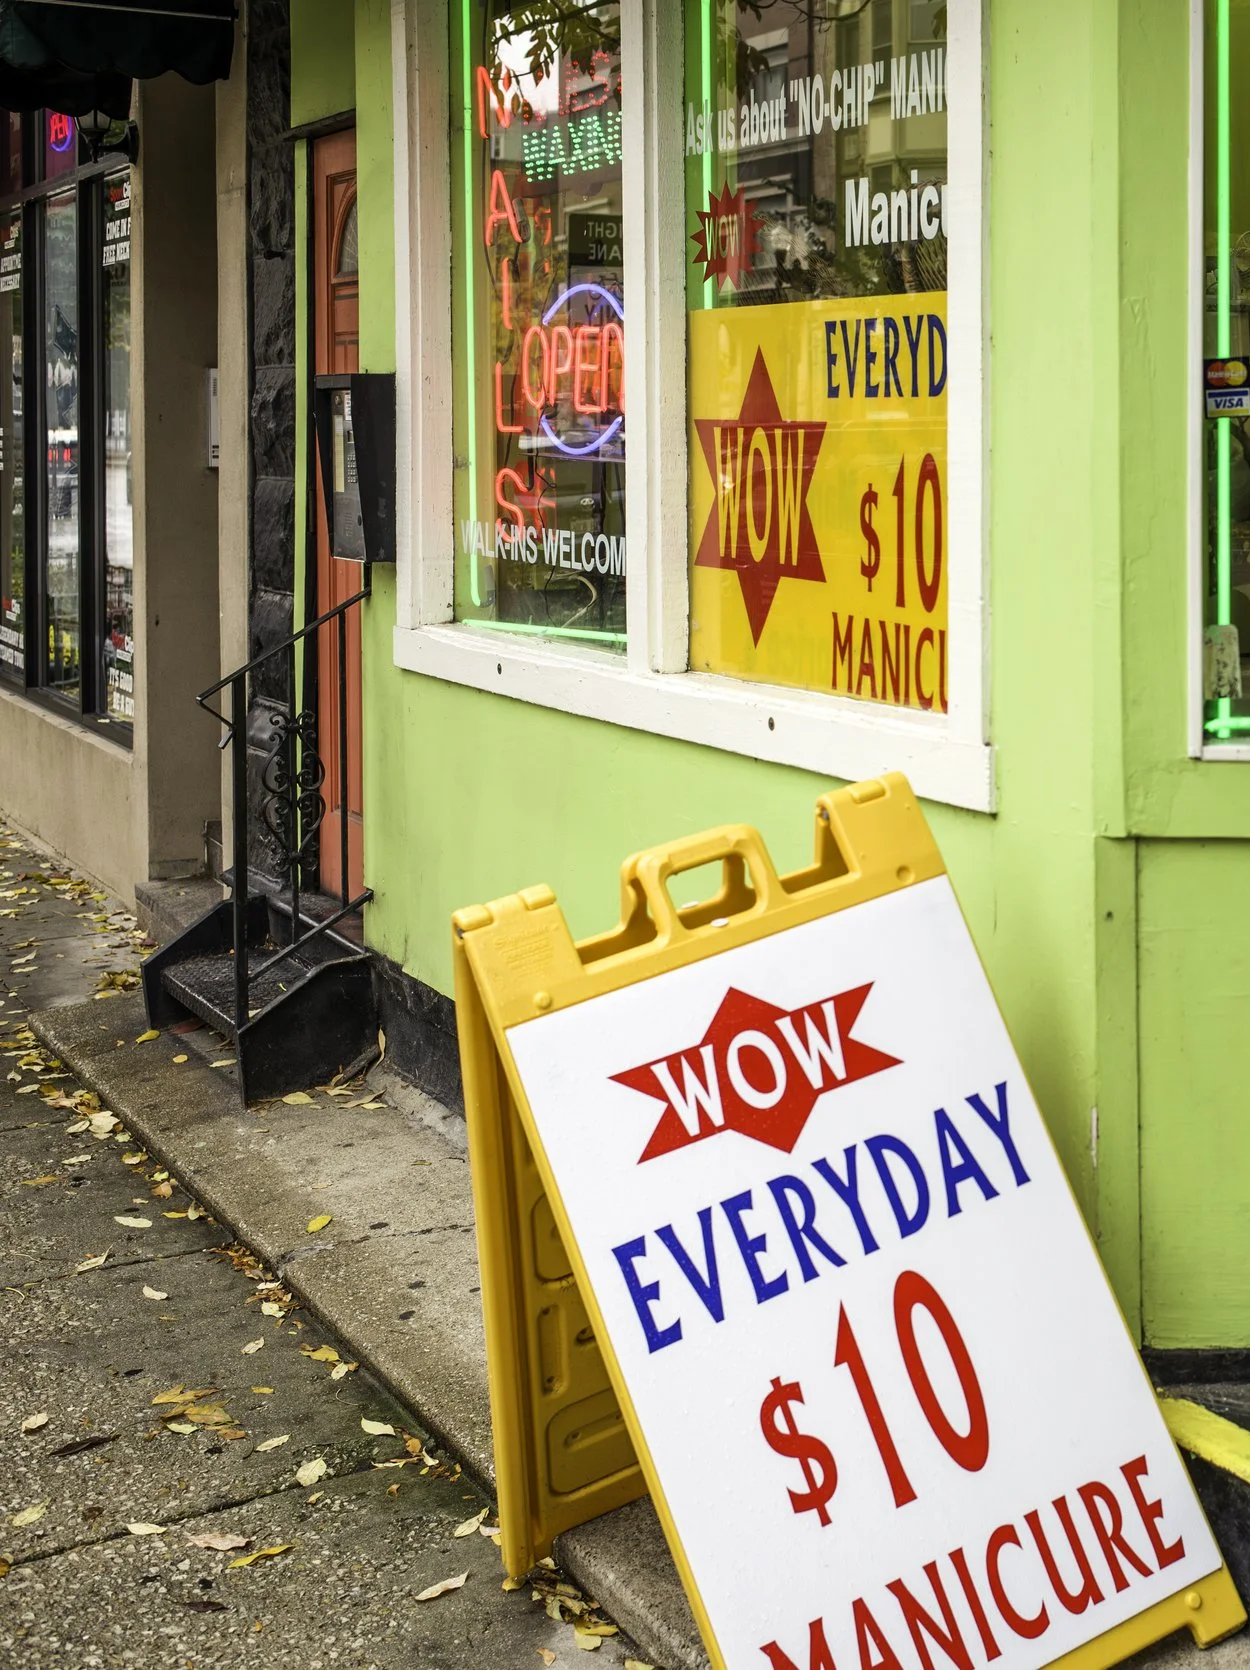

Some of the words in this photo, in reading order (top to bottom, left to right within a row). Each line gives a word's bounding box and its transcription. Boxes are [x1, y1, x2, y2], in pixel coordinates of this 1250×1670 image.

[685, 99, 714, 156] Ask
[718, 105, 735, 151] us
[740, 85, 787, 147] about
[790, 61, 884, 137] "NO-CHIP"
[522, 322, 624, 413] OPEN
[824, 314, 947, 398] EVERYD
[1214, 398, 1243, 409] VISA
[460, 519, 538, 564] WALK-INS
[541, 528, 626, 577] WELCOM
[714, 426, 805, 566] WOW
[860, 452, 942, 614] $10
[650, 1000, 847, 1137] WOW
[611, 1081, 1031, 1354] EVERYDAY
[760, 1269, 989, 1527] $10
